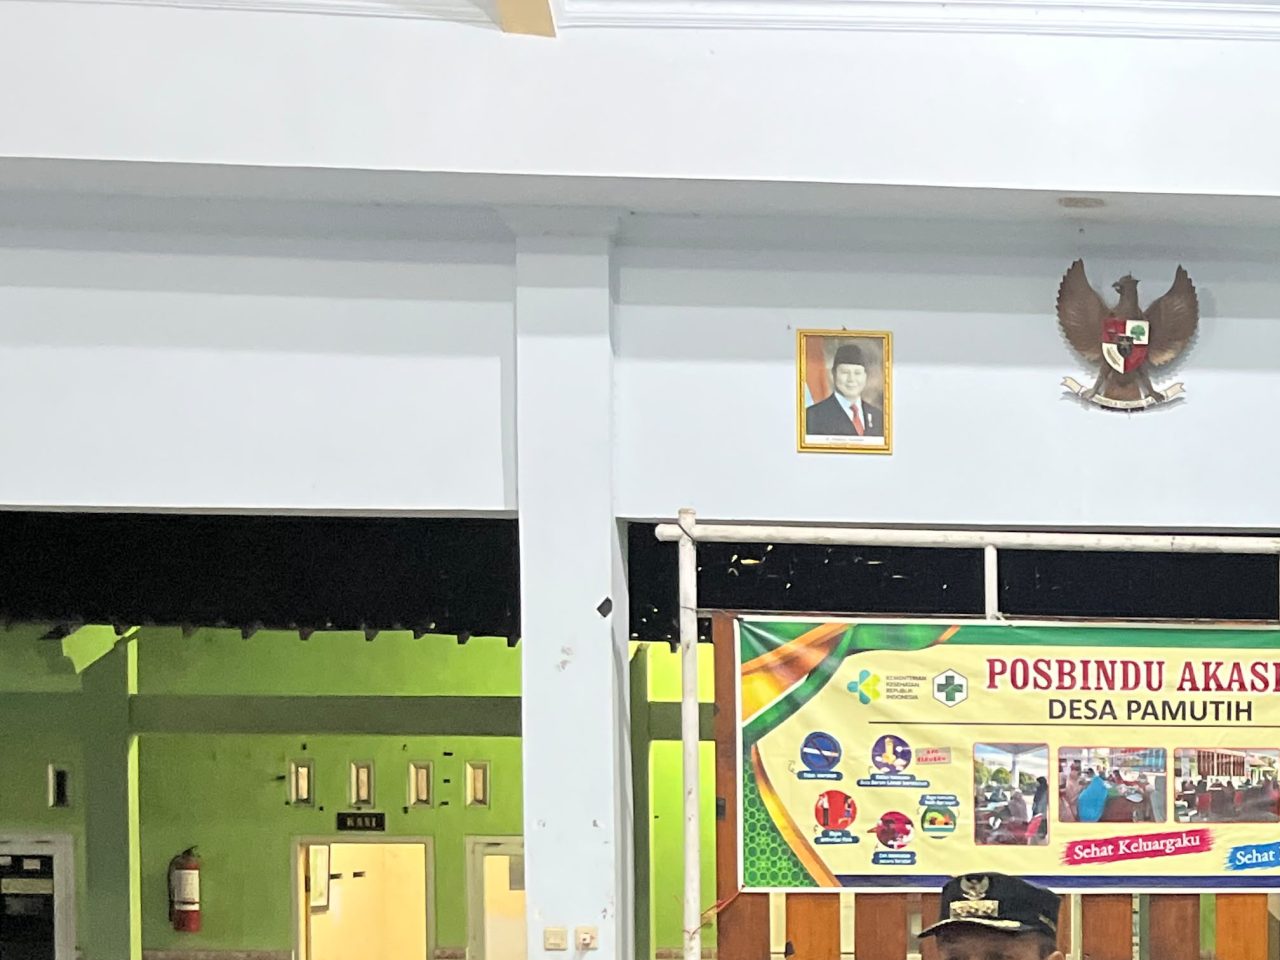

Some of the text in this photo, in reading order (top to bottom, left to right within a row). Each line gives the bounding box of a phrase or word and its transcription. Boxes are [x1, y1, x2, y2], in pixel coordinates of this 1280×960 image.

[986, 658, 1165, 691] POSBINDU
[1048, 699, 1253, 721] DESA PAMUTIH
[1073, 835, 1201, 860] Sehat Keluargaku
[1235, 847, 1275, 866] Sehat
